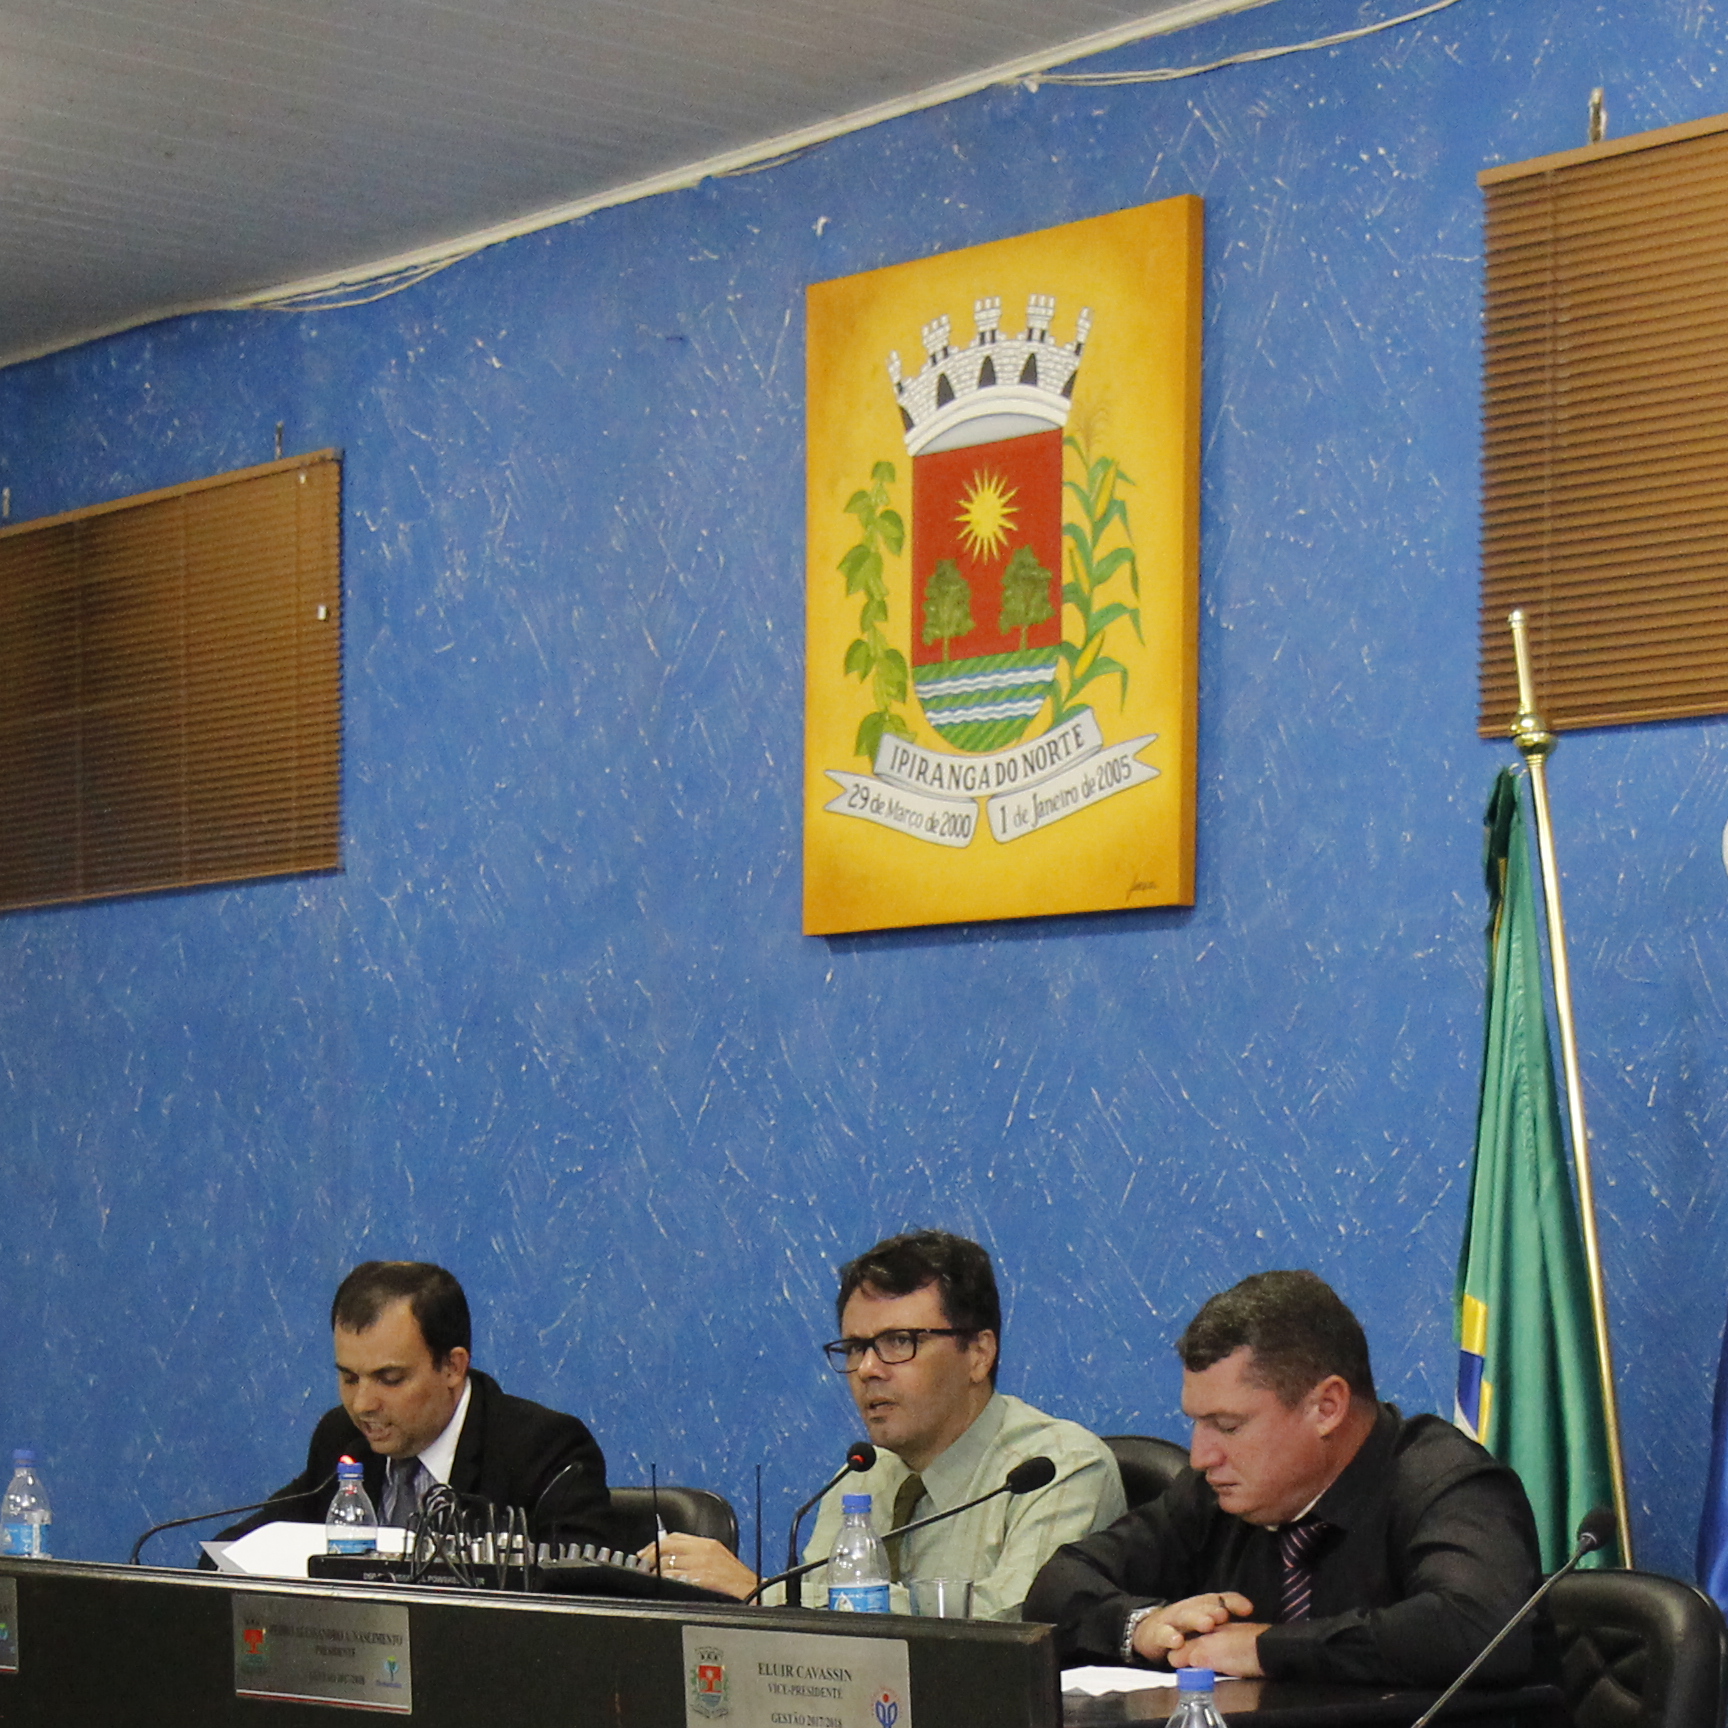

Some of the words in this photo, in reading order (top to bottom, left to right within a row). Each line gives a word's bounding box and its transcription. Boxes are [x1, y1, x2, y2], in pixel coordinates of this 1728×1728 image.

[890, 745, 991, 791] IPIRANGA
[996, 757, 1019, 785] DO
[1021, 724, 1086, 780] NORTE
[847, 783, 869, 810] 29
[870, 791, 886, 815] de
[885, 799, 924, 830] Março
[924, 808, 940, 834] de
[939, 811, 972, 840] 2000
[1000, 805, 1008, 834] 1
[1013, 801, 1029, 826] de
[1030, 782, 1078, 829] Janeiro
[1082, 772, 1098, 799] de
[1097, 754, 1133, 788] 2005
[758, 1662, 796, 1679] ELUIR
[796, 1665, 853, 1683] CAVASSIN
[767, 1683, 843, 1700] VICE-PRESIDENTE
